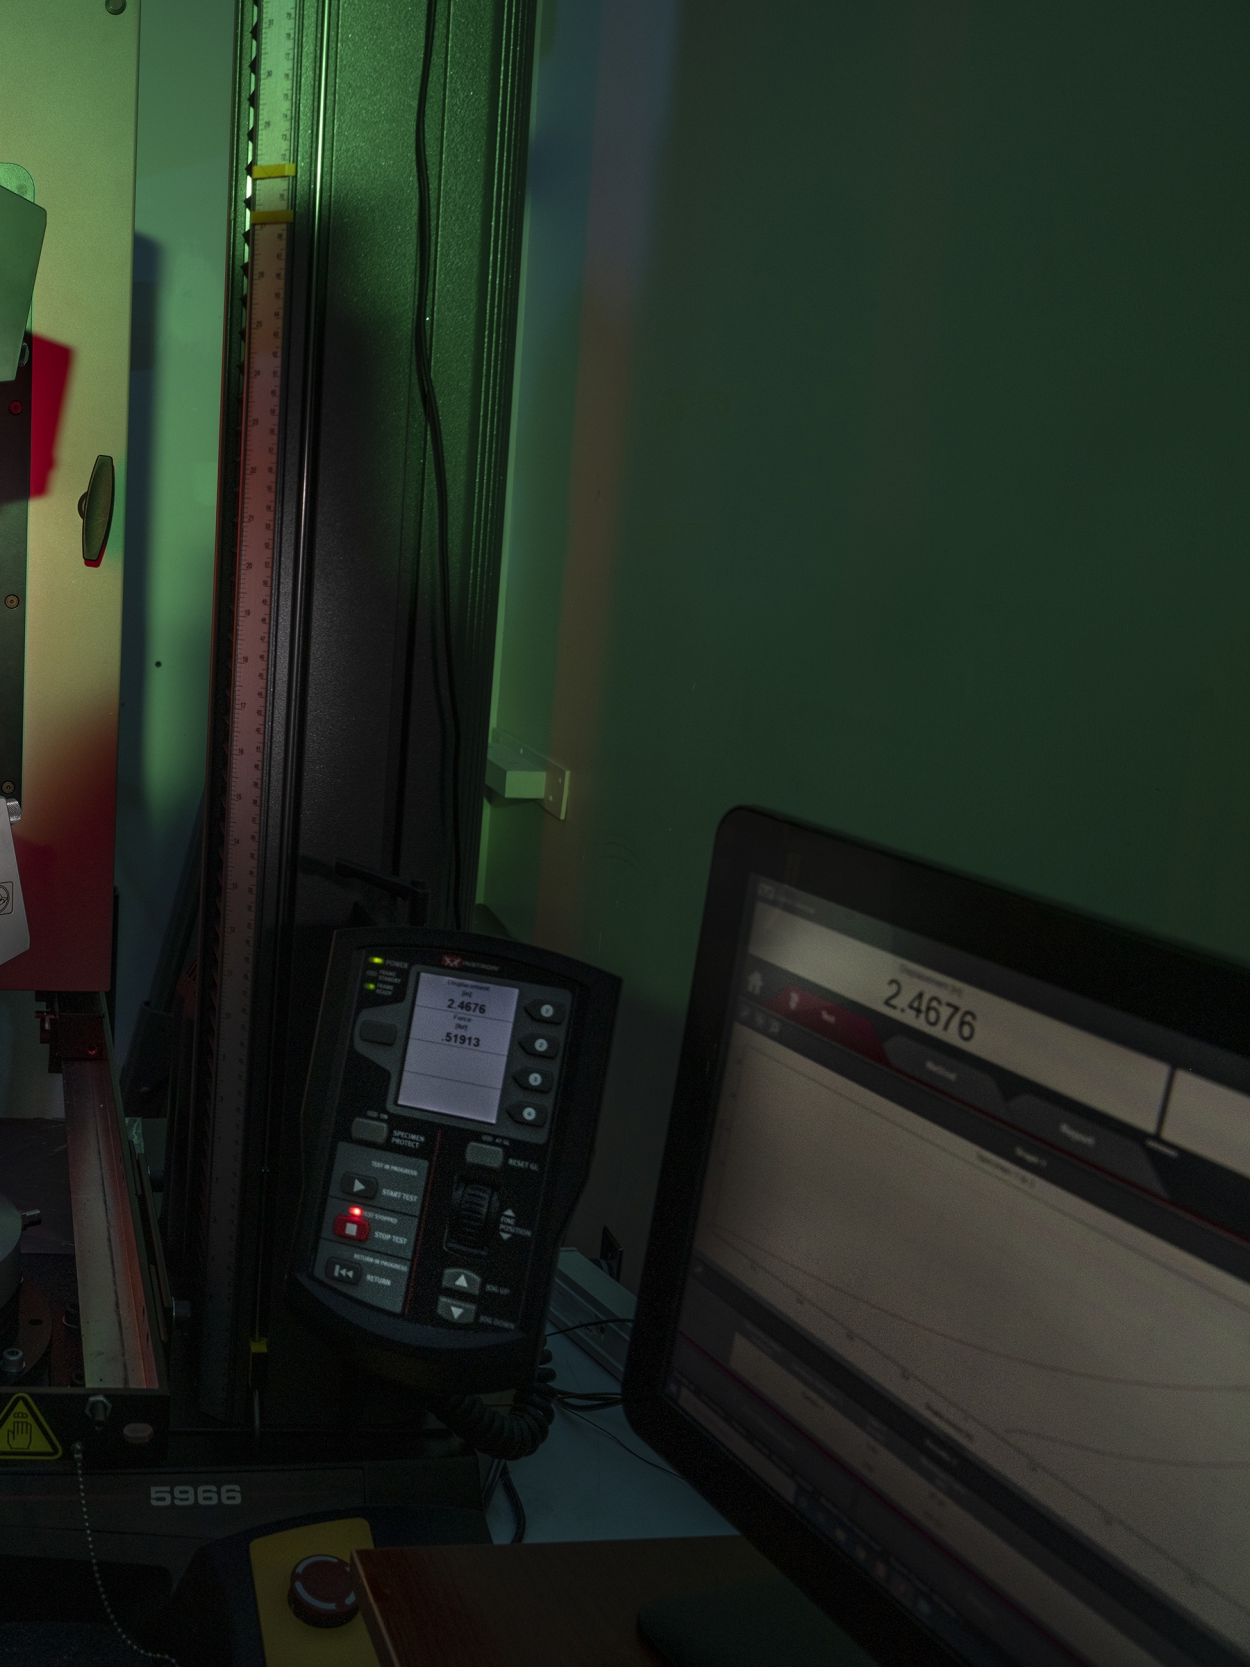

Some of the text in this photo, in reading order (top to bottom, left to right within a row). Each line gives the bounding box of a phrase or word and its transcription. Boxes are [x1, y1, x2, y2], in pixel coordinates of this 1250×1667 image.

[385, 959, 409, 969] POWER
[447, 980, 490, 992] Displacement
[447, 999, 486, 1014] 2.4676
[883, 978, 978, 1042] 2.4676
[454, 1014, 472, 1023] Force
[441, 1032, 481, 1047] .51913
[391, 1137, 420, 1149] PROTECT
[392, 1130, 425, 1143] SPECIMEN
[508, 1158, 528, 1168] RESET
[382, 1188, 418, 1202] START TEST
[500, 1224, 532, 1237] POSITION
[375, 1231, 407, 1245] STOP TEST
[366, 1274, 391, 1286] RETURN
[150, 1484, 242, 1506] 5966
